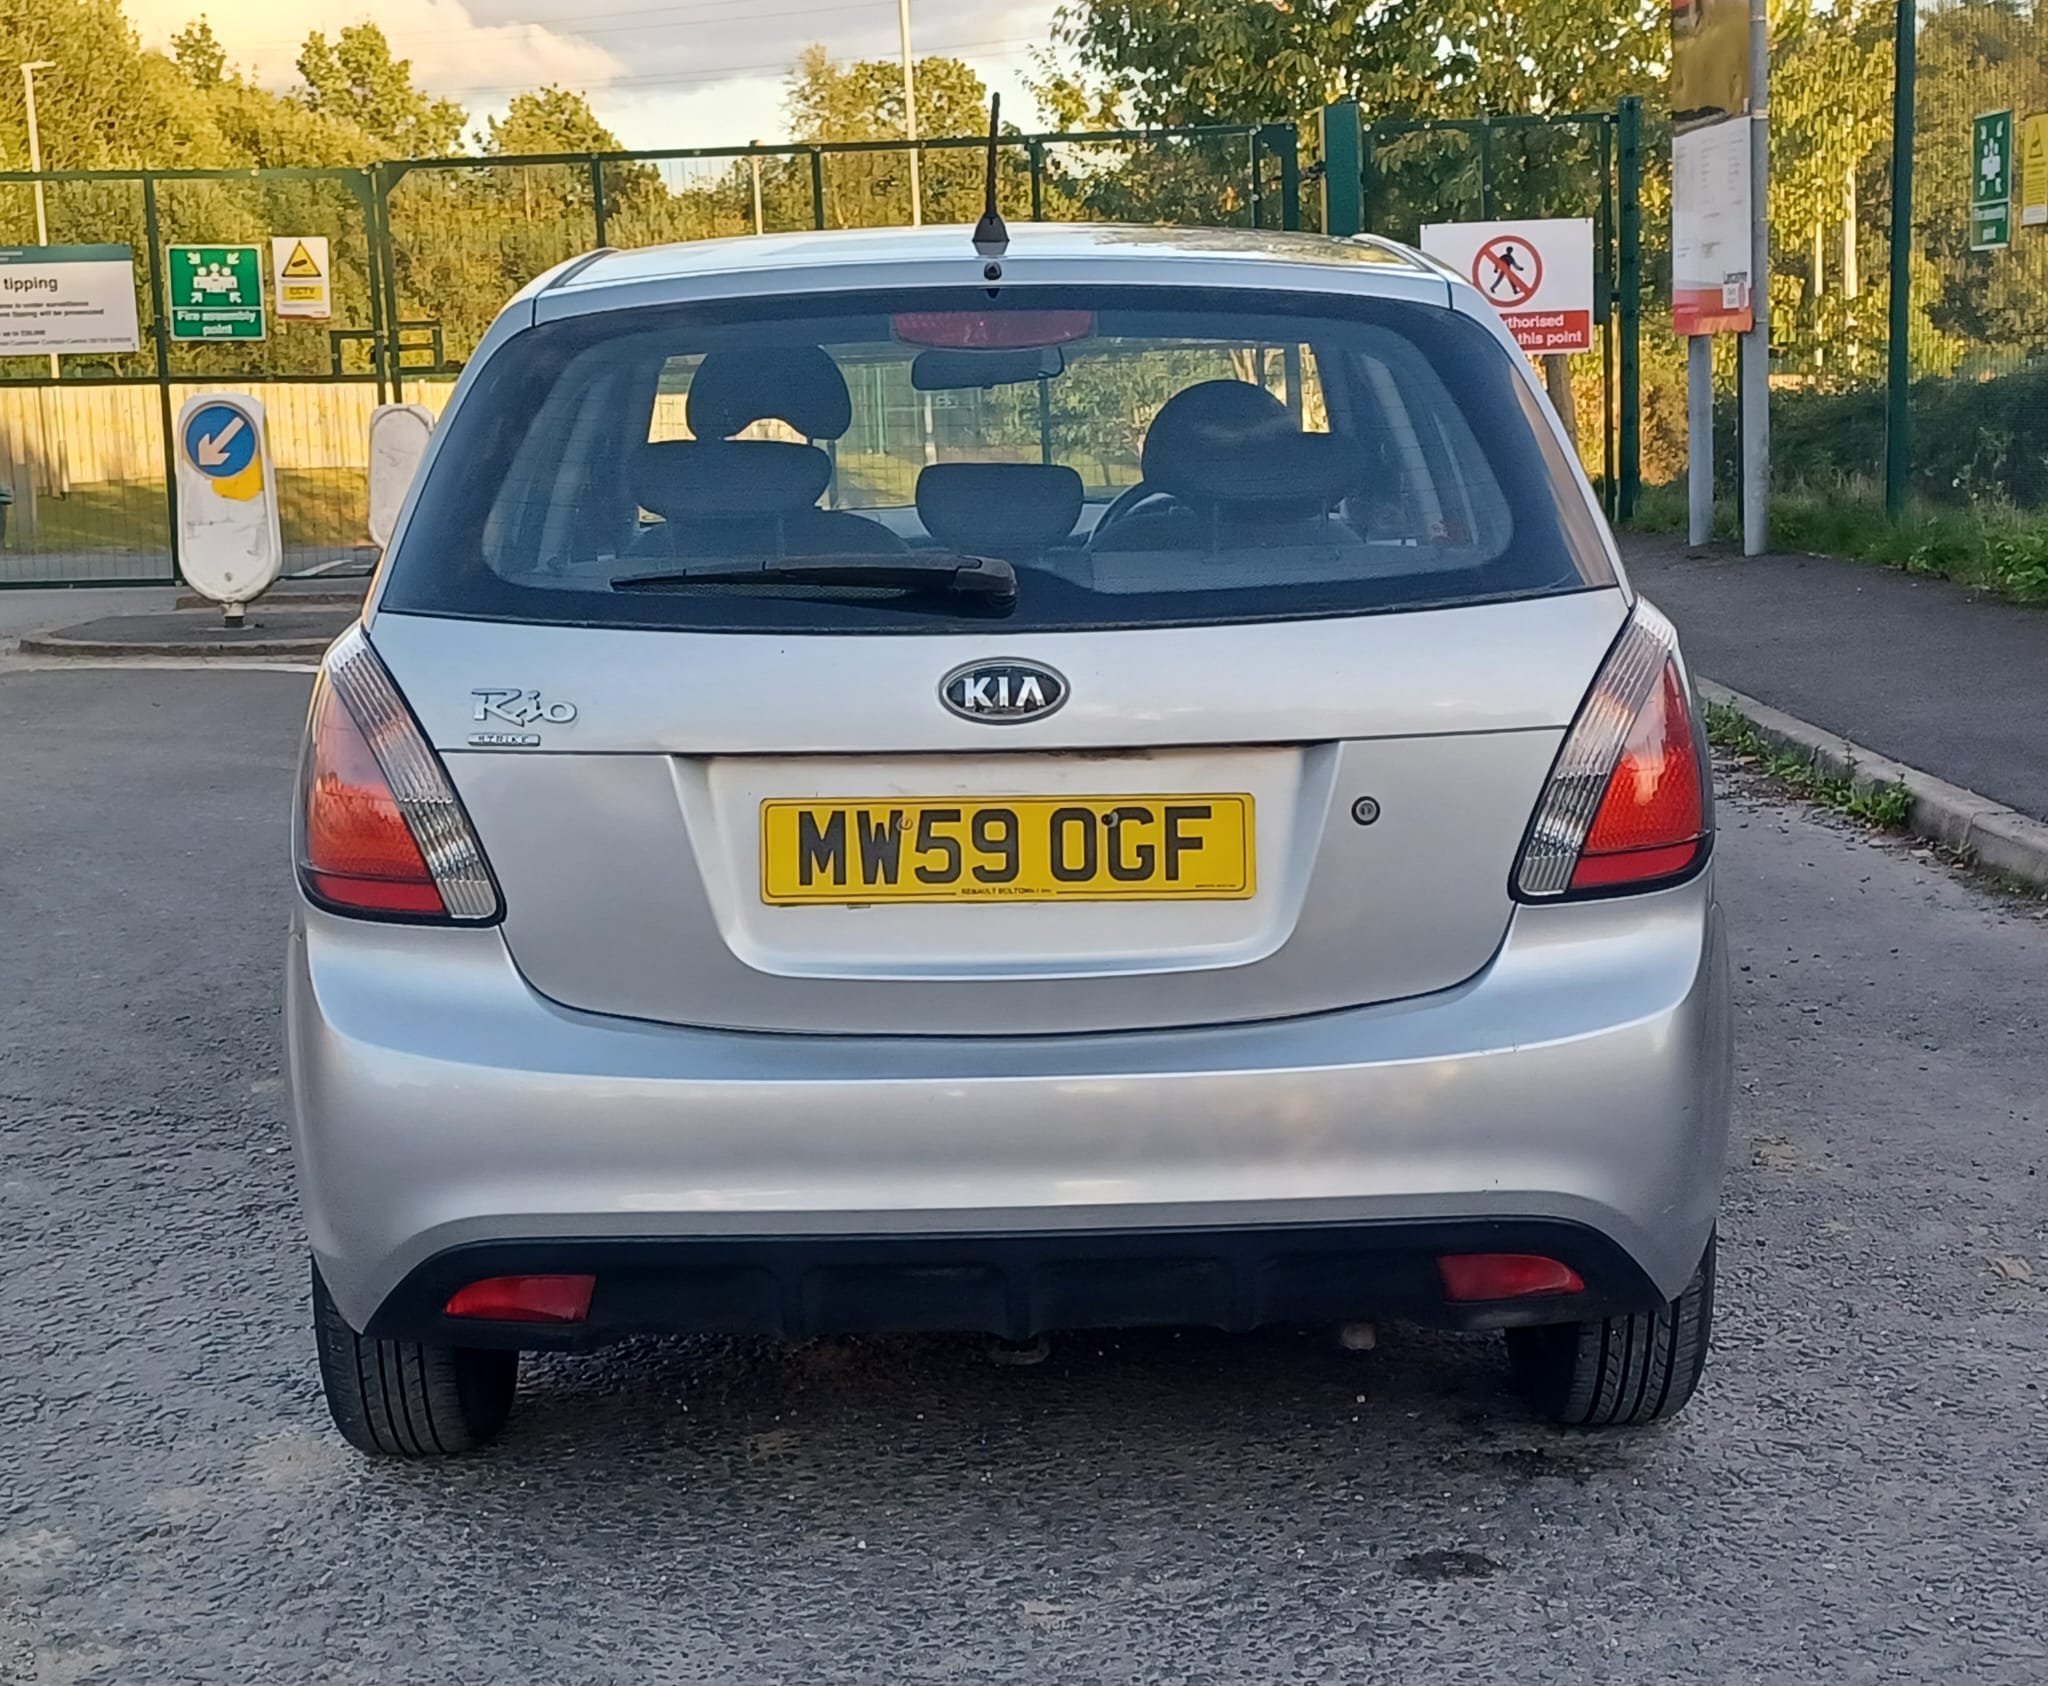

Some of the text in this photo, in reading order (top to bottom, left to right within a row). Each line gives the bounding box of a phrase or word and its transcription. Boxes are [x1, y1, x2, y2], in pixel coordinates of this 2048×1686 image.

[3, 276, 59, 293] tipping
[289, 286, 316, 295] CCTV
[177, 310, 200, 321] Fire
[1504, 314, 1564, 329] thorised
[1517, 330, 1582, 347] this point
[963, 675, 1046, 708] KIA
[471, 688, 578, 727] Rio
[798, 806, 1212, 886] MW59 OGF
